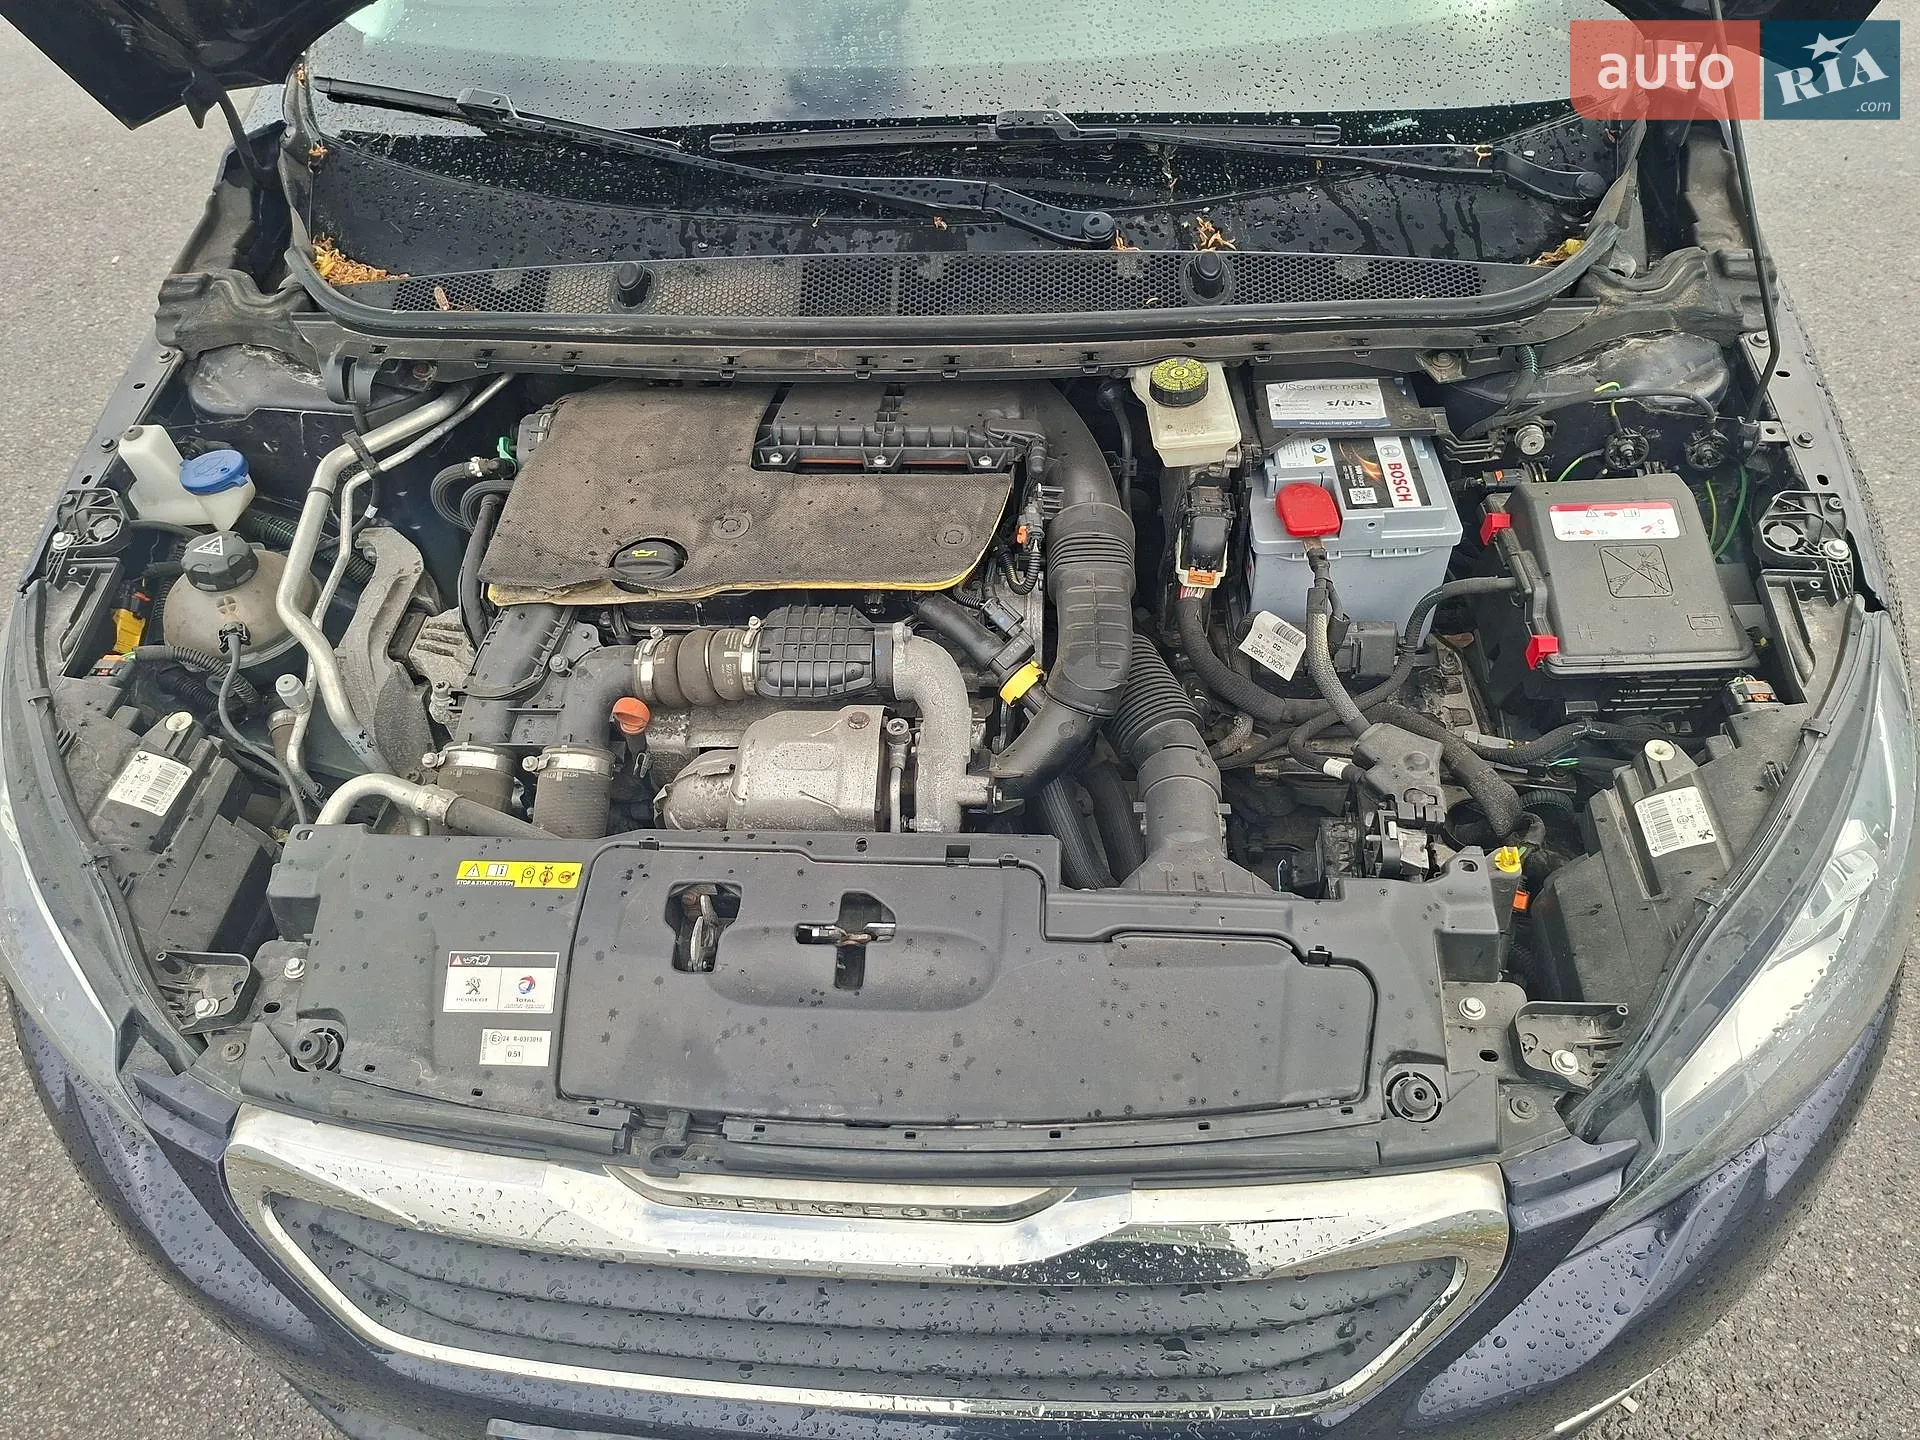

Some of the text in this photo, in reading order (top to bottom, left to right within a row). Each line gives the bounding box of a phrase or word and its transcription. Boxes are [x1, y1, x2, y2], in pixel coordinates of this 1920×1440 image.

[1278, 383, 1340, 392] VISSCHER
[1387, 462, 1413, 502] BOSCH
[507, 1050, 521, 1058] 0.51
